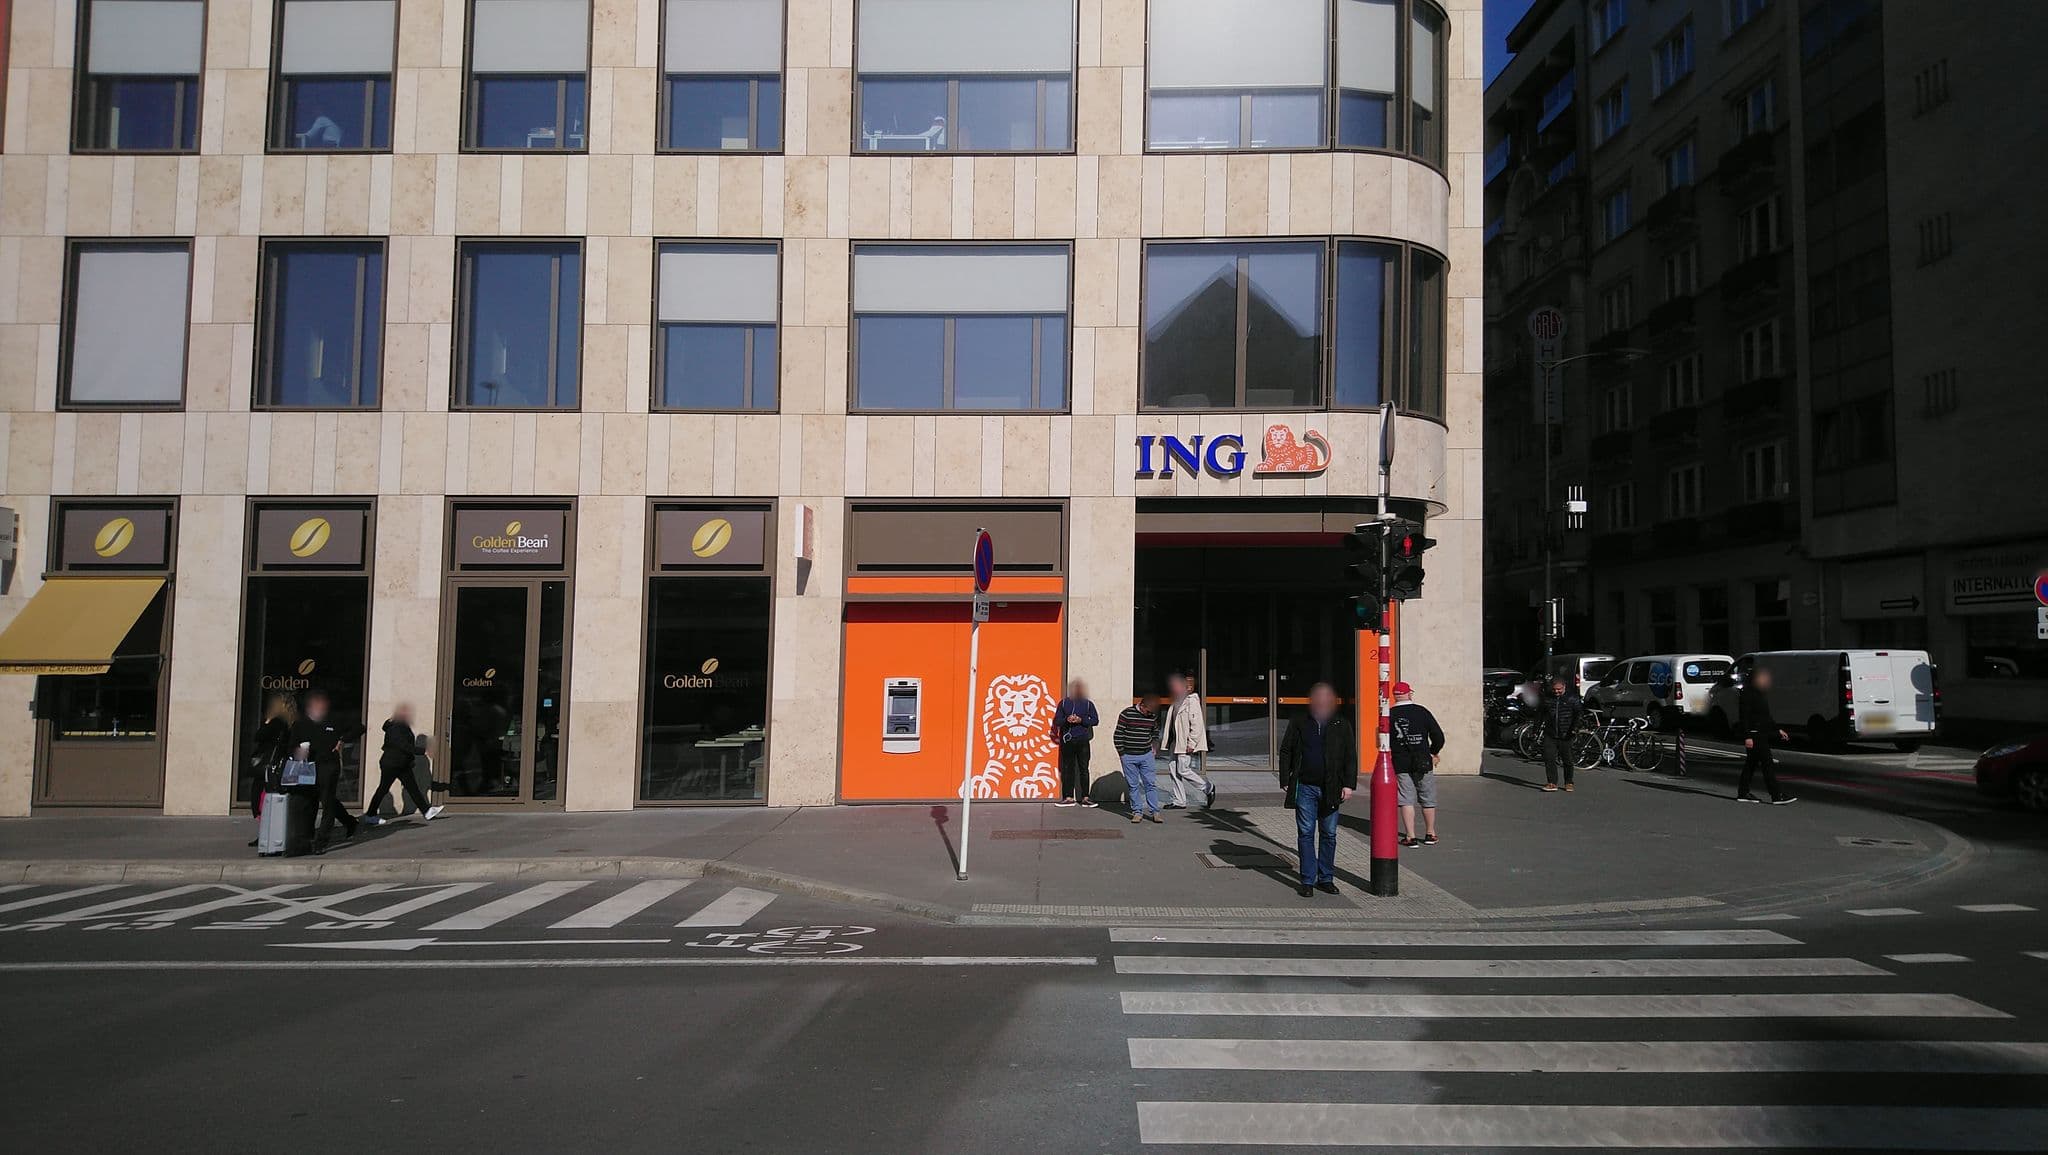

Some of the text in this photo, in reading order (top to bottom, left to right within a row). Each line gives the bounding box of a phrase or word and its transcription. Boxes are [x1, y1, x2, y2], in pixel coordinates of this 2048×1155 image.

[1136, 434, 1248, 474] ING
[472, 535, 549, 549] Golden Bean
[261, 675, 309, 689] Golden
[462, 677, 493, 687] Golden
[664, 674, 713, 689] Golden
